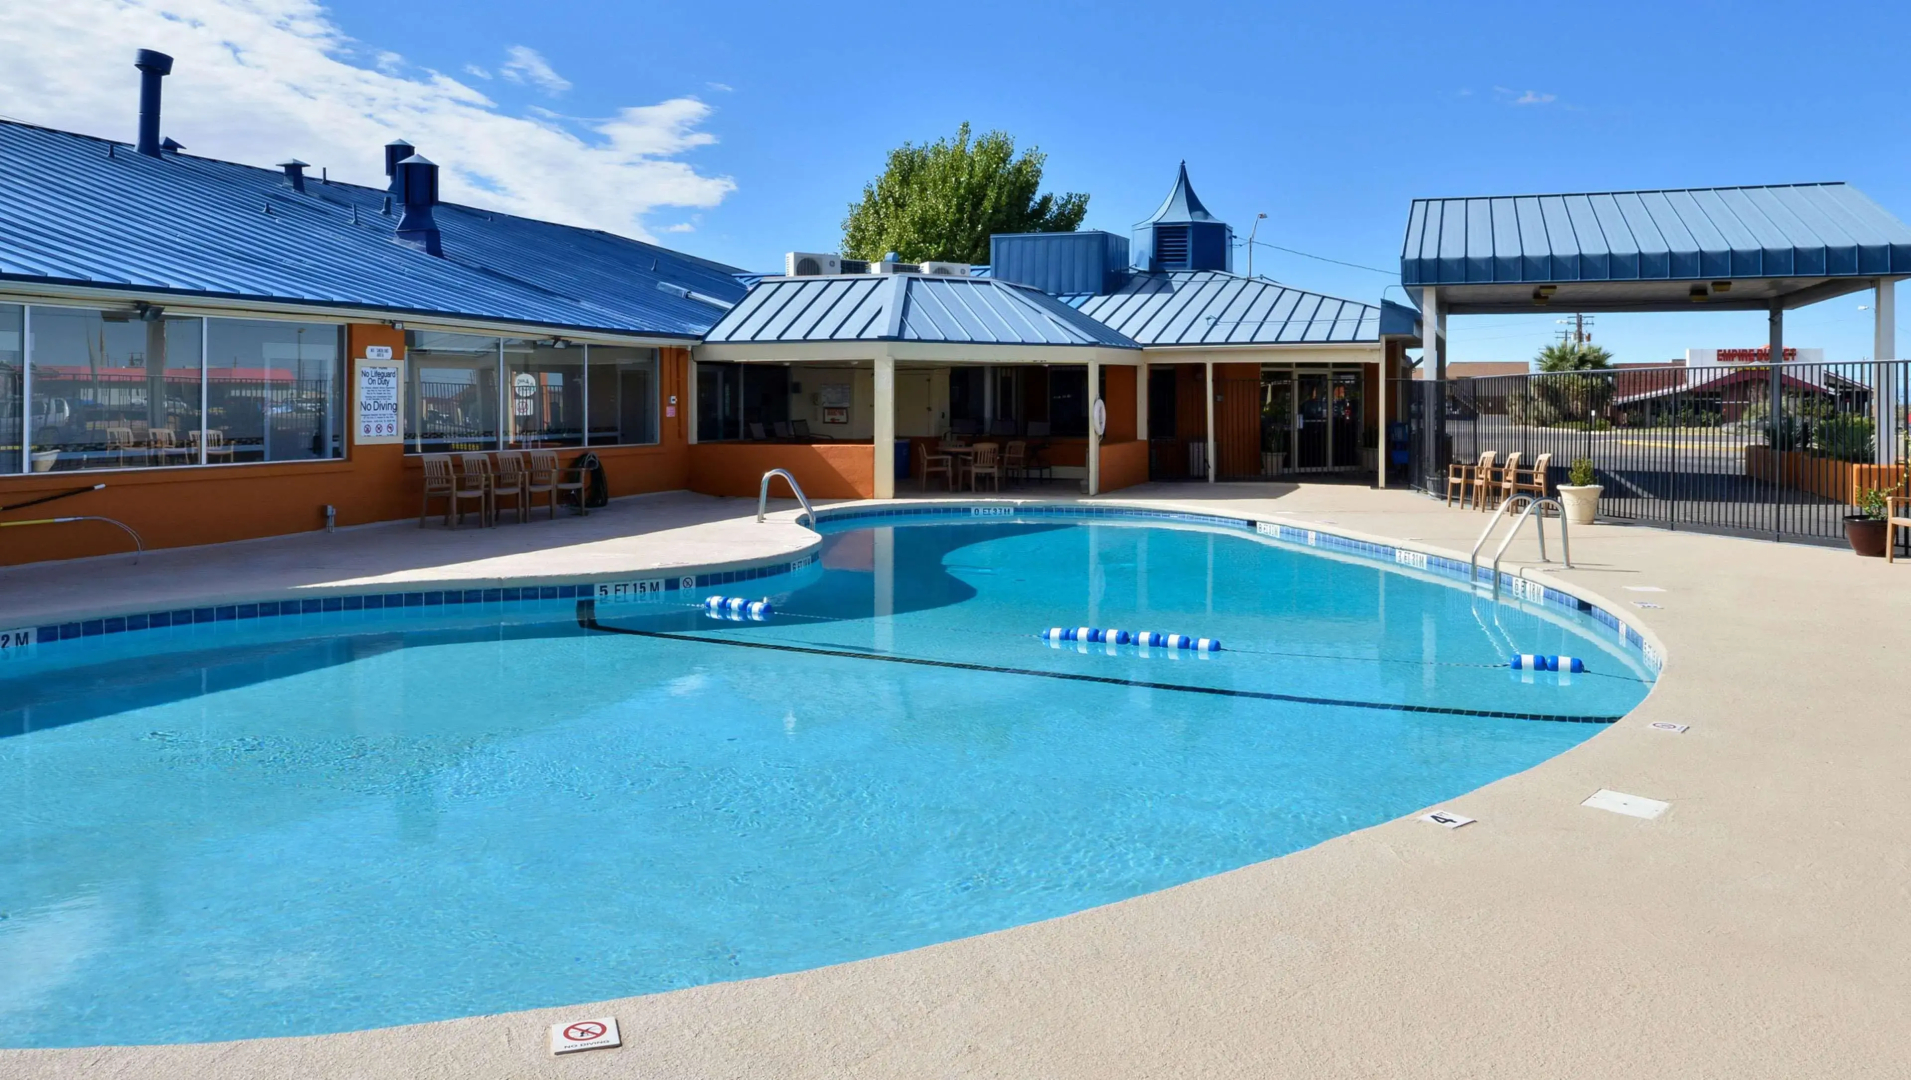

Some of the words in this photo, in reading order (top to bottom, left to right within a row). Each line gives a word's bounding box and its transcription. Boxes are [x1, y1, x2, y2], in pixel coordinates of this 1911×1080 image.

[1717, 349, 1754, 361] EMPIRE
[1757, 348, 1796, 361] BUET
[361, 370, 370, 378] No
[371, 370, 396, 380] Lifeguard
[377, 378, 390, 387] Duty
[360, 401, 372, 411] No
[373, 400, 398, 413] Diving
[599, 585, 608, 596] 5
[614, 583, 629, 595] FT
[633, 582, 646, 594] 15
[650, 581, 660, 592] M
[15, 631, 29, 646] M
[1430, 815, 1457, 824] 4
